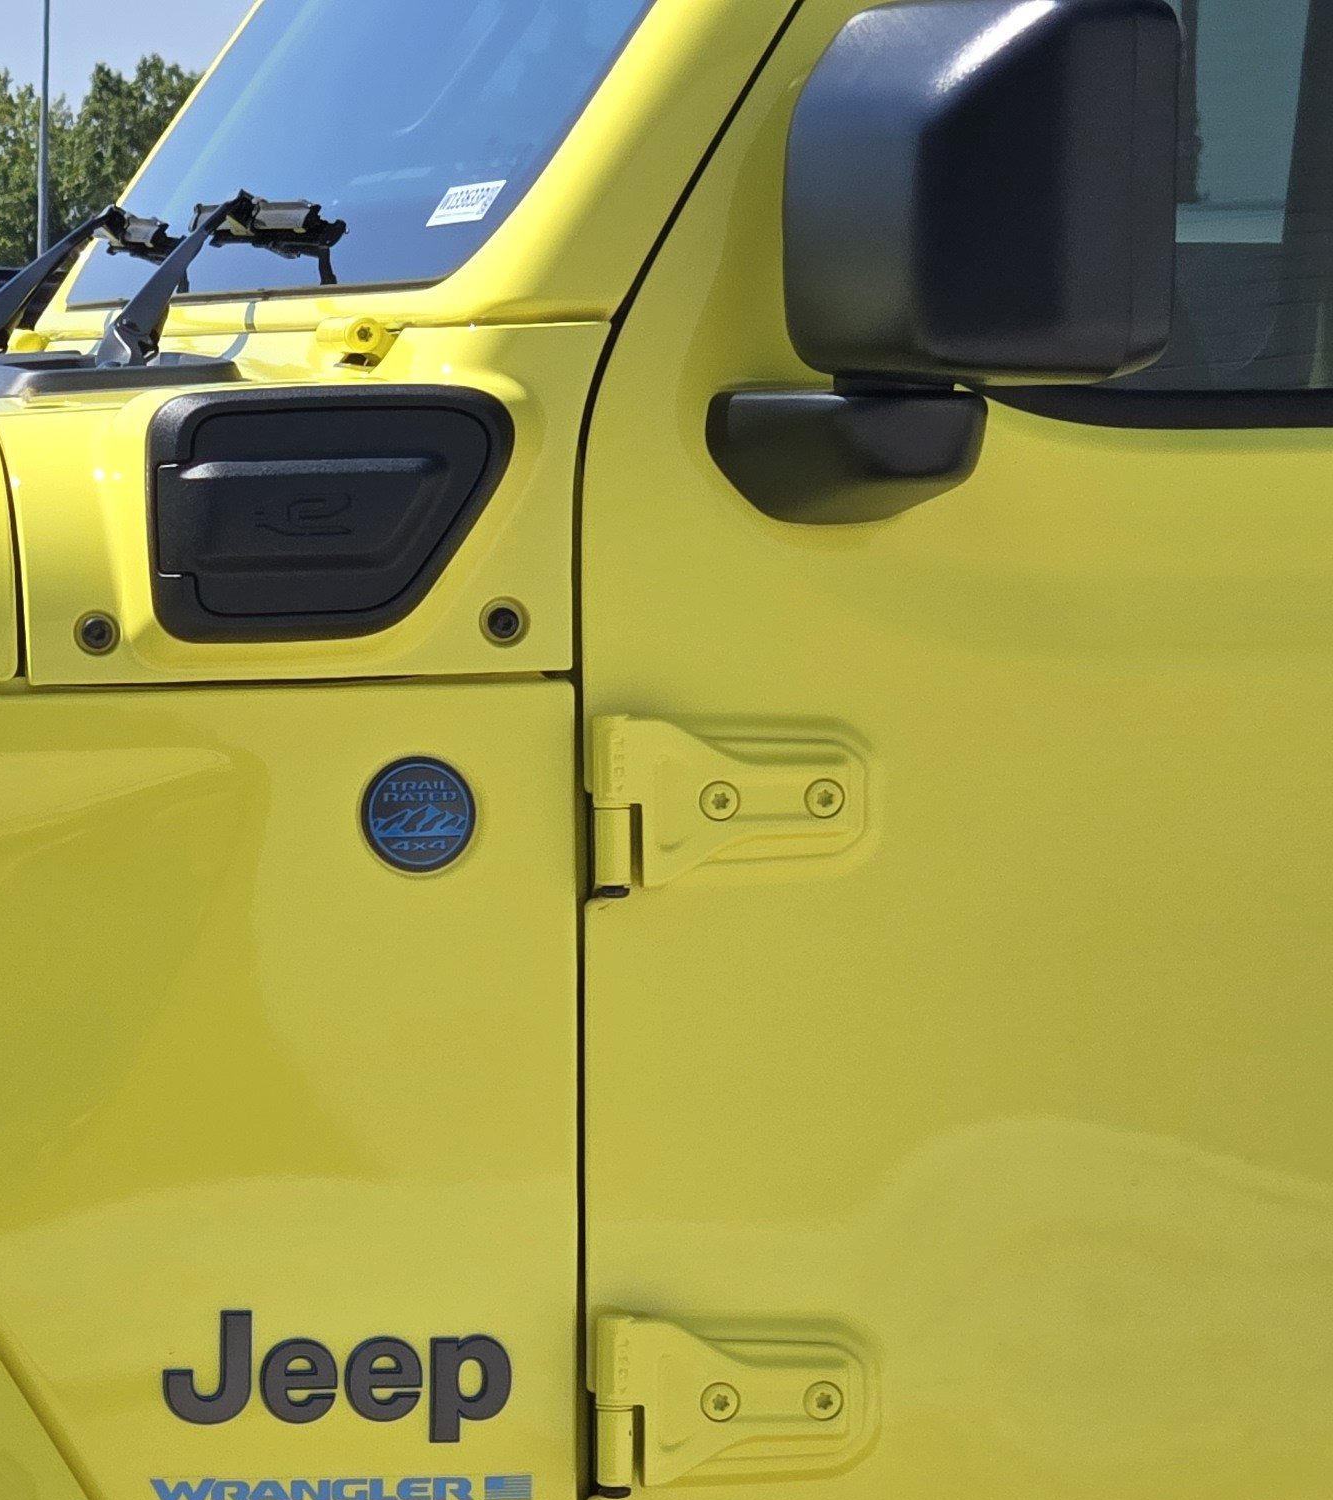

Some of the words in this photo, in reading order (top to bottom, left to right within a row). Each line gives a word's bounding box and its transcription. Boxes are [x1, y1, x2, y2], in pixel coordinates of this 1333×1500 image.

[386, 780, 447, 791] TRAIL
[383, 791, 457, 803] RATED
[162, 1309, 513, 1444] Jeep
